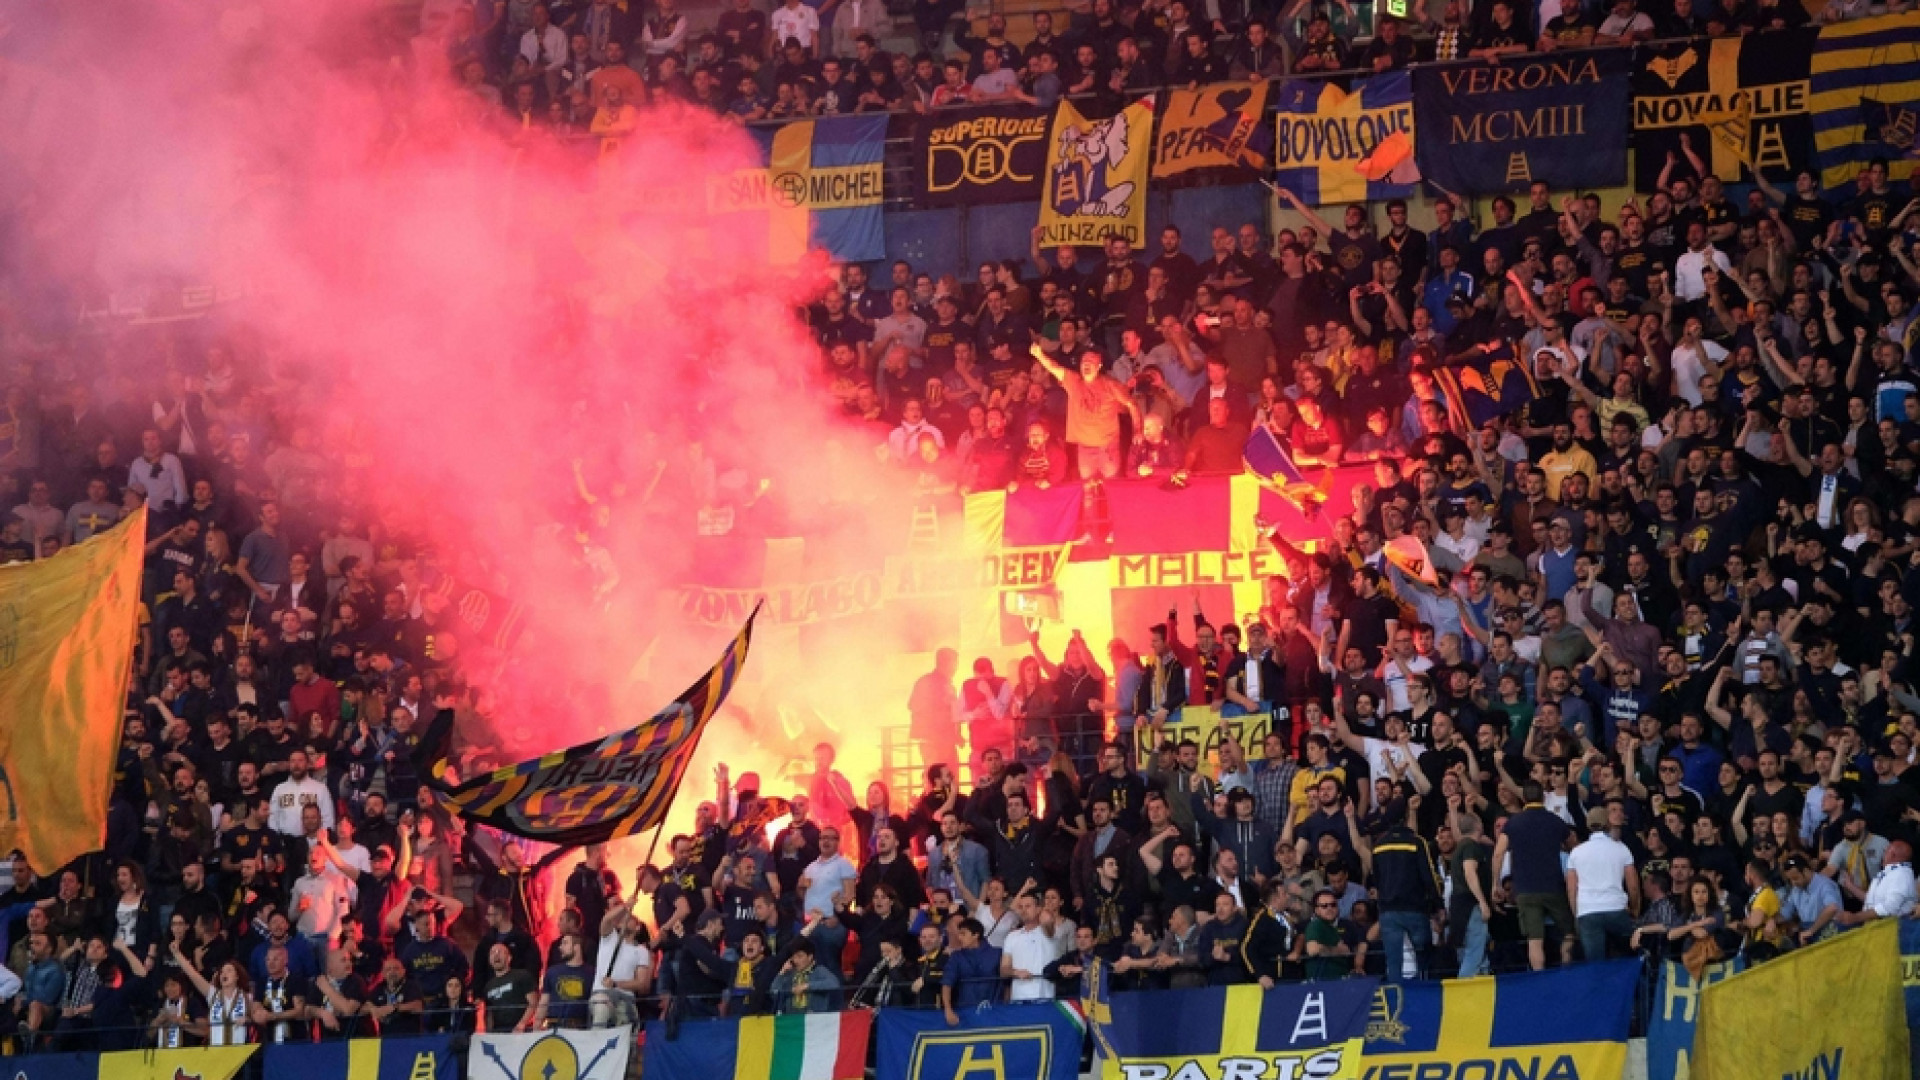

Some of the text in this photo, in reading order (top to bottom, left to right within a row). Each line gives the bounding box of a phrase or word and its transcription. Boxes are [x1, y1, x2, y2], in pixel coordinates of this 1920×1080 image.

[1440, 56, 1601, 96] VERONA
[929, 115, 1048, 143] SUPERIORE
[1450, 104, 1586, 145] MCMIII
[928, 136, 1043, 191] DOC
[730, 174, 767, 204] SAN
[810, 171, 883, 203] MICHEL
[1120, 1048, 1344, 1080] PARIS
